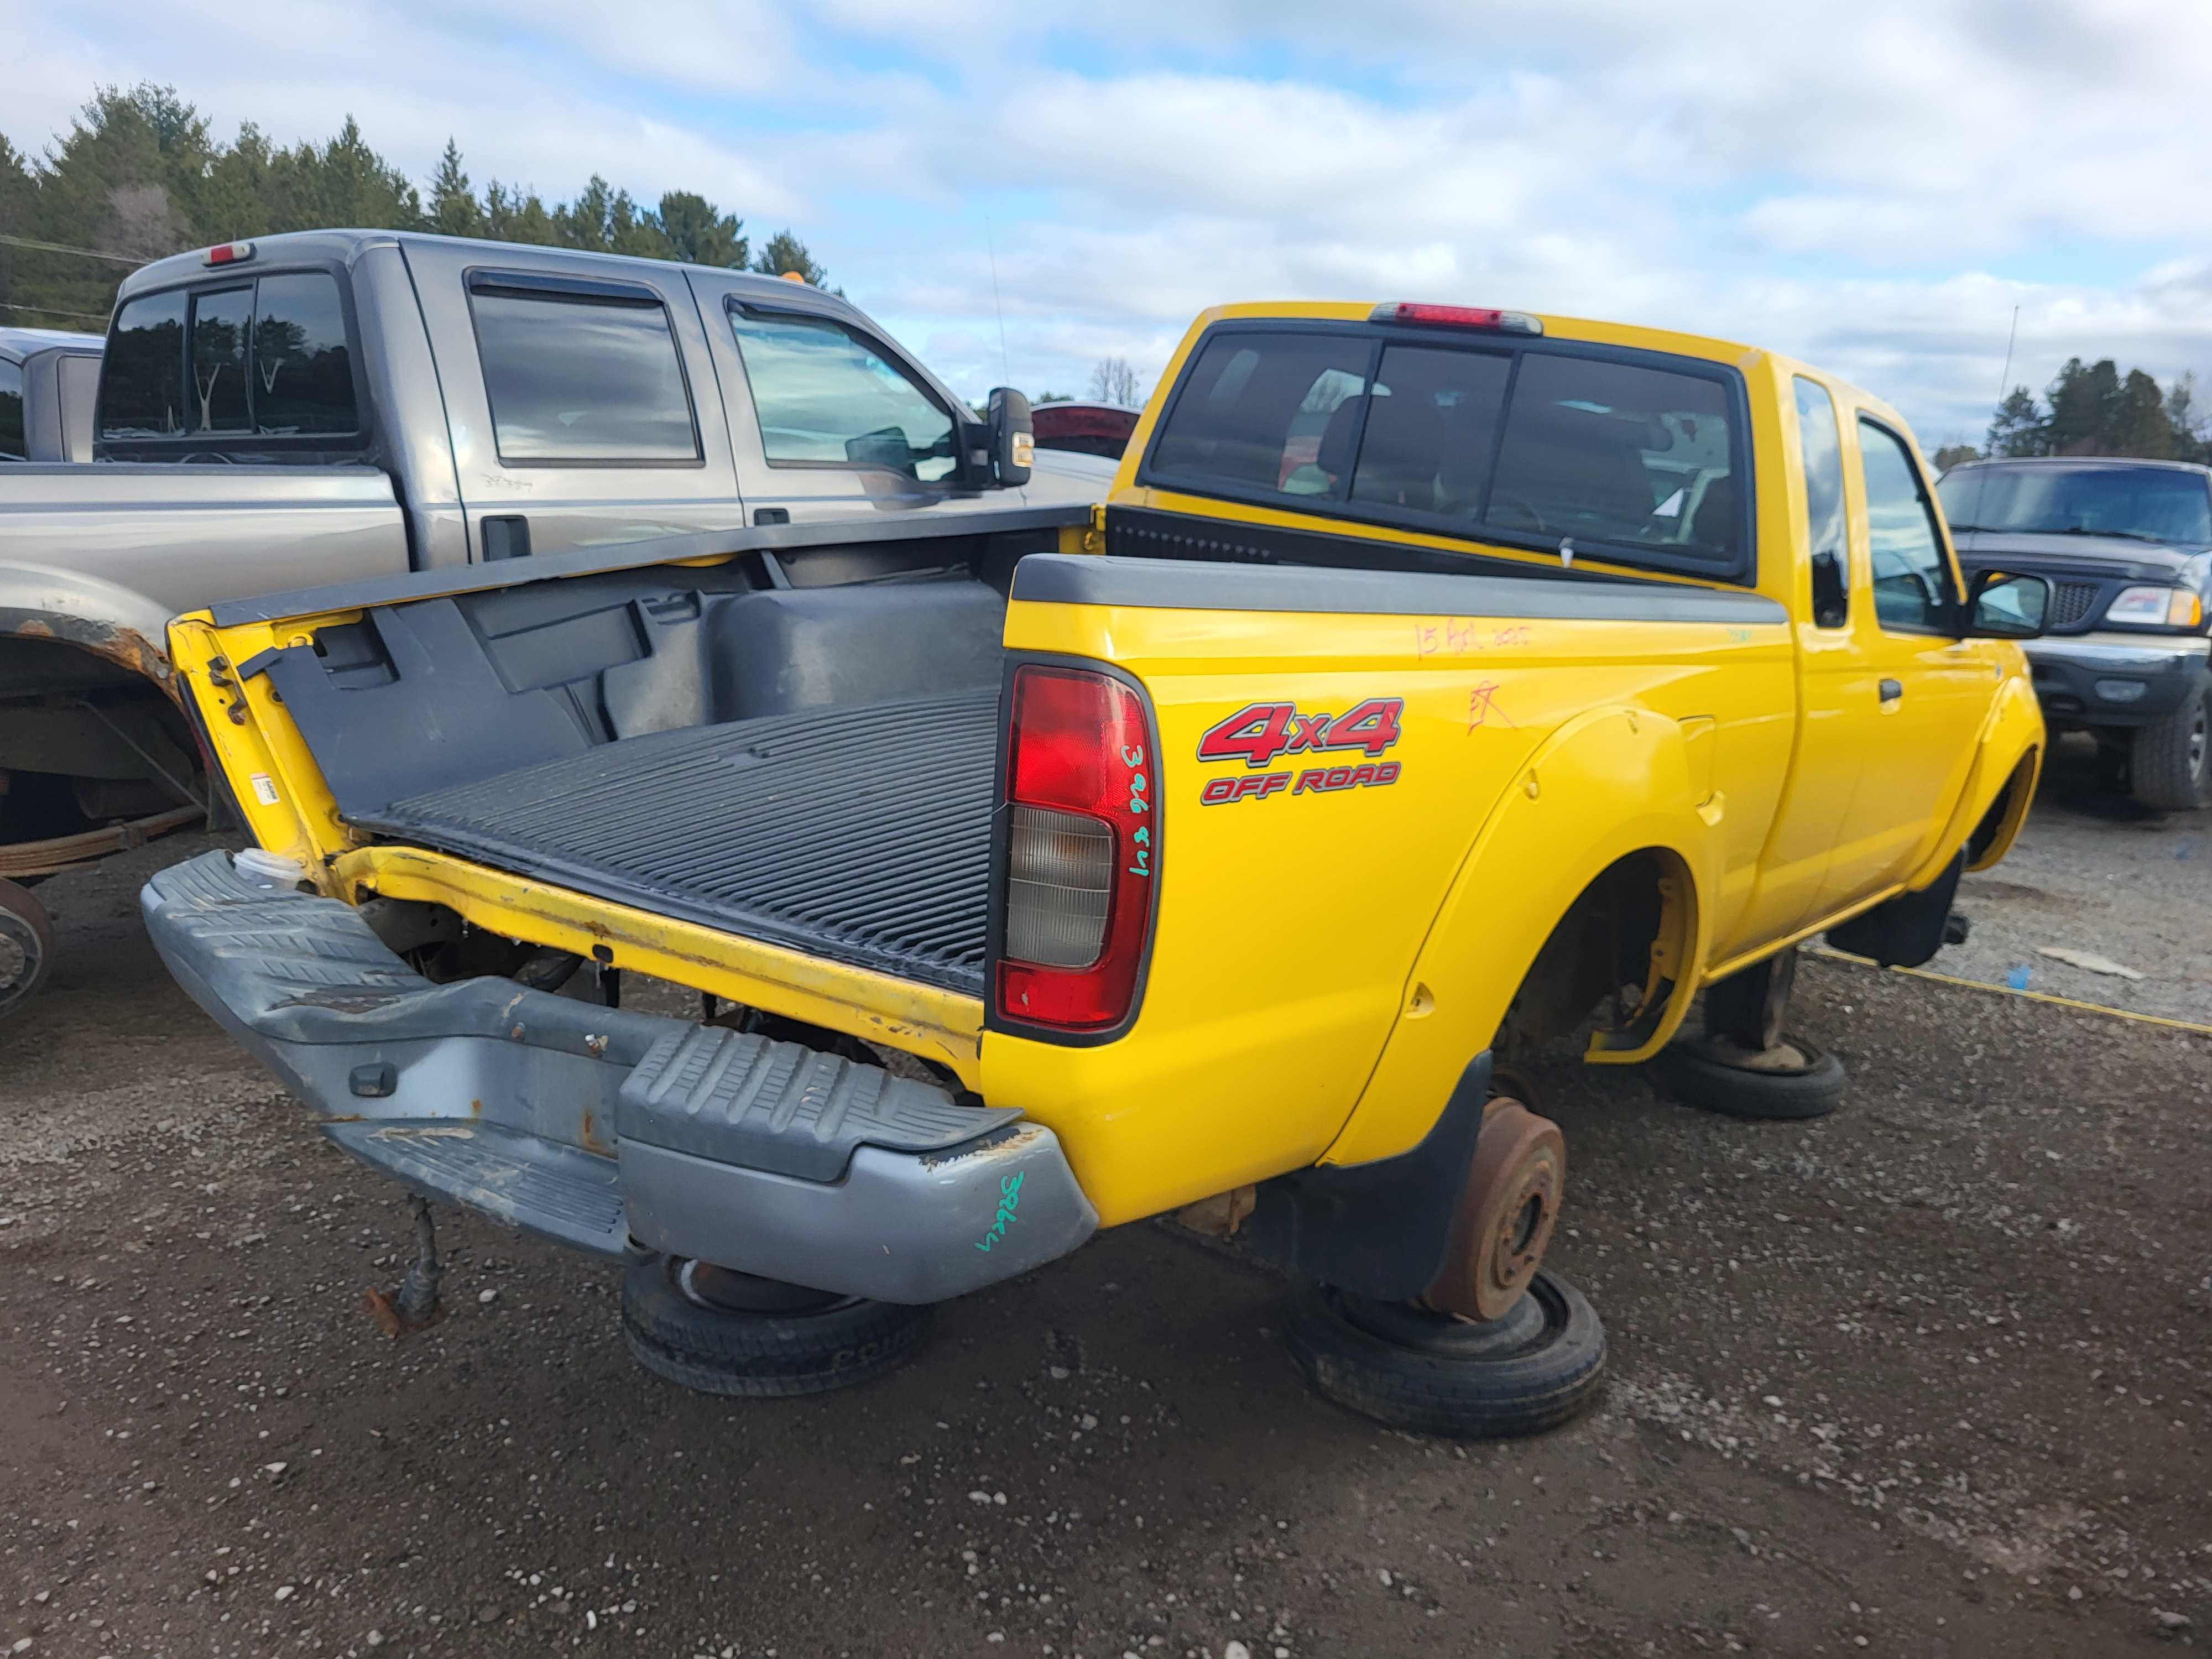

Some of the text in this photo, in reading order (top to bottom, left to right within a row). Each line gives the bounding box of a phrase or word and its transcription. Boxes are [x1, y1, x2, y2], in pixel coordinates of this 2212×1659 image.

[1415, 623, 1438, 662] 15
[1197, 697, 1404, 769] 4x4
[1200, 761, 1401, 806] OFF ROAD
